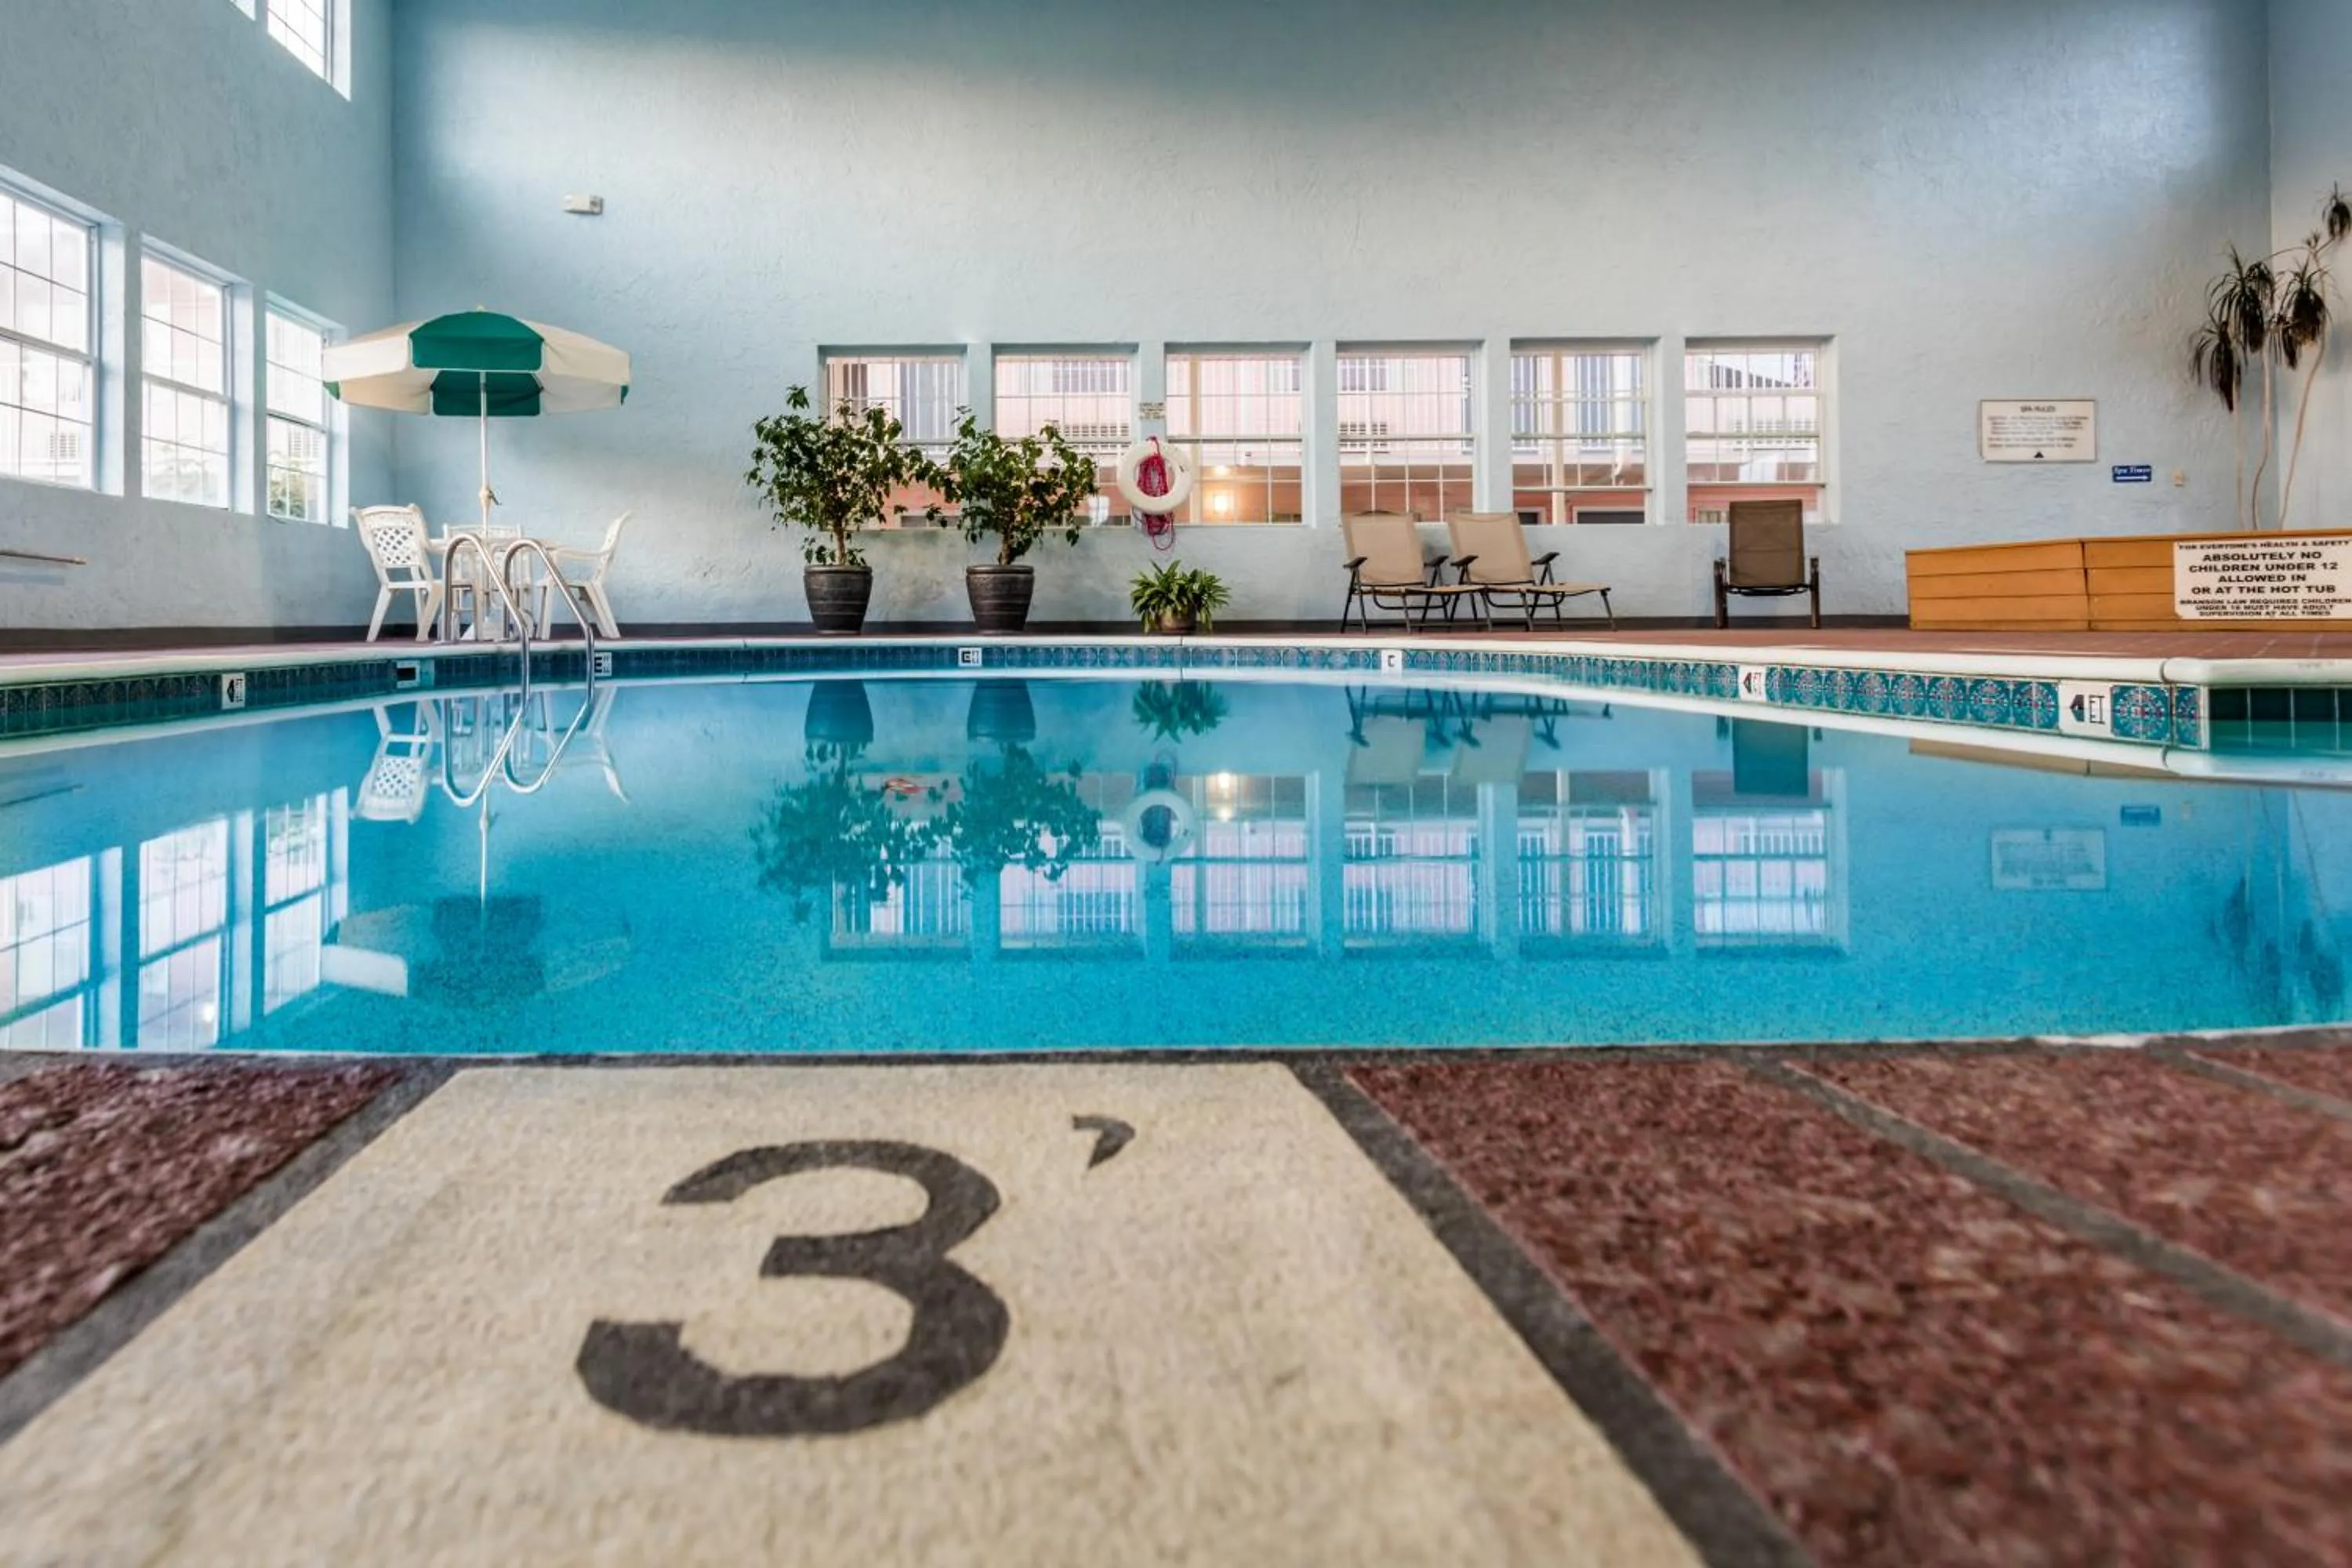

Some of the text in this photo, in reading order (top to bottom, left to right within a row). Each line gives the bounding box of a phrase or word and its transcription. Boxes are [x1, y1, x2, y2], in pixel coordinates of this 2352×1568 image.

[2203, 552, 2296, 561] ABSOLUTELY
[2189, 564, 2260, 573] CHILDREN
[2265, 562, 2316, 572] UNDER
[2307, 585, 2336, 593] TUB
